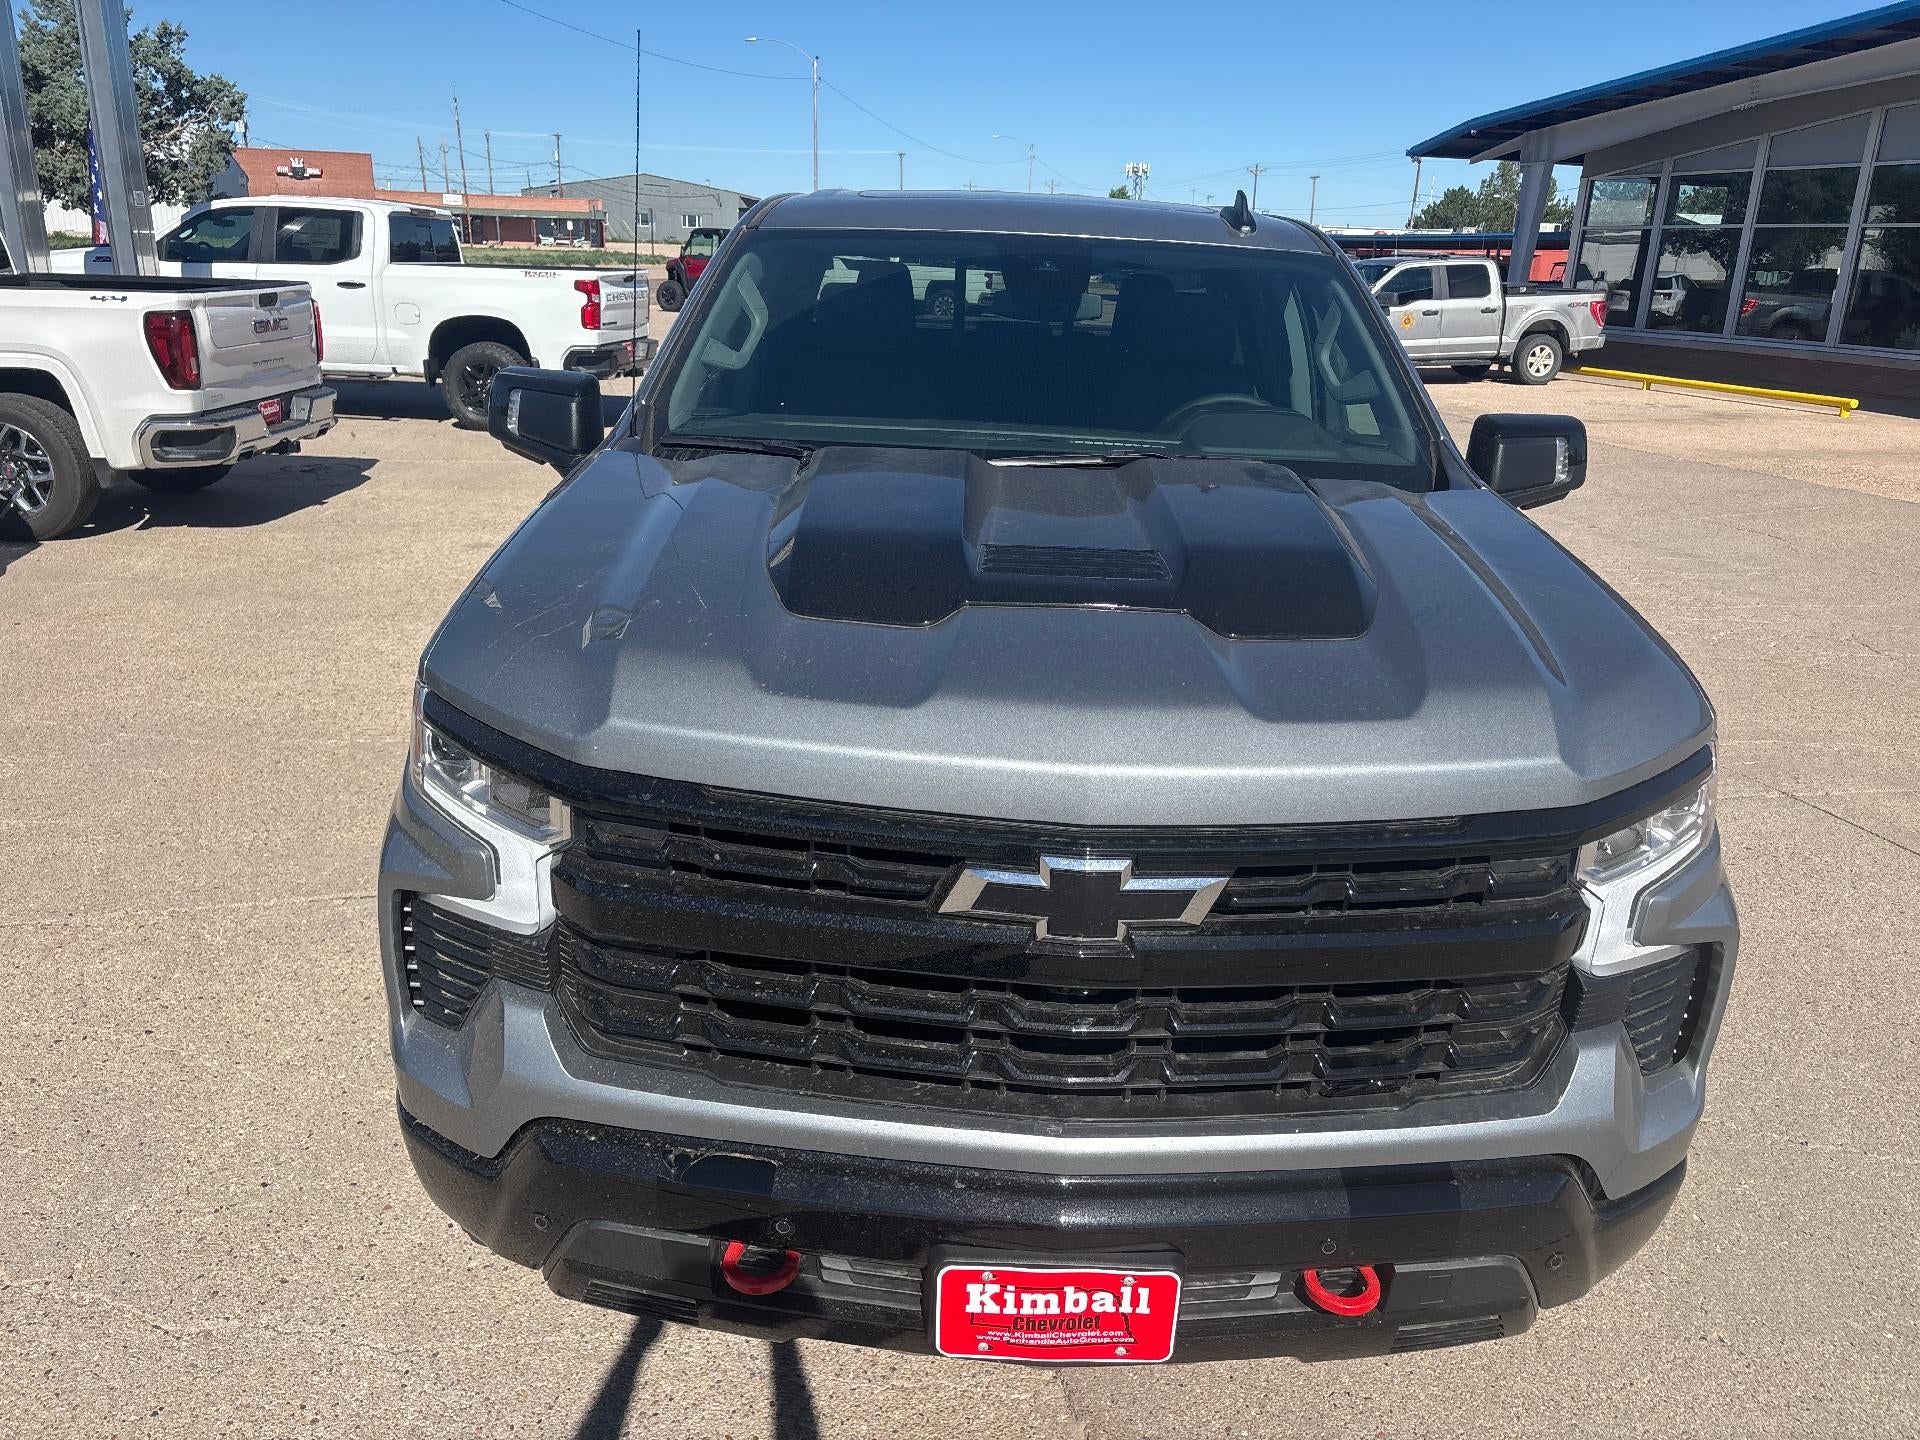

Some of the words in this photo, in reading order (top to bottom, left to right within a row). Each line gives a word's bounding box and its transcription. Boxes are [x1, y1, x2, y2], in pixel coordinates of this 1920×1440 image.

[254, 317, 288, 333] GMC
[965, 1283, 1150, 1315] Kimball
[1012, 1315, 1101, 1331] Chevrolet
